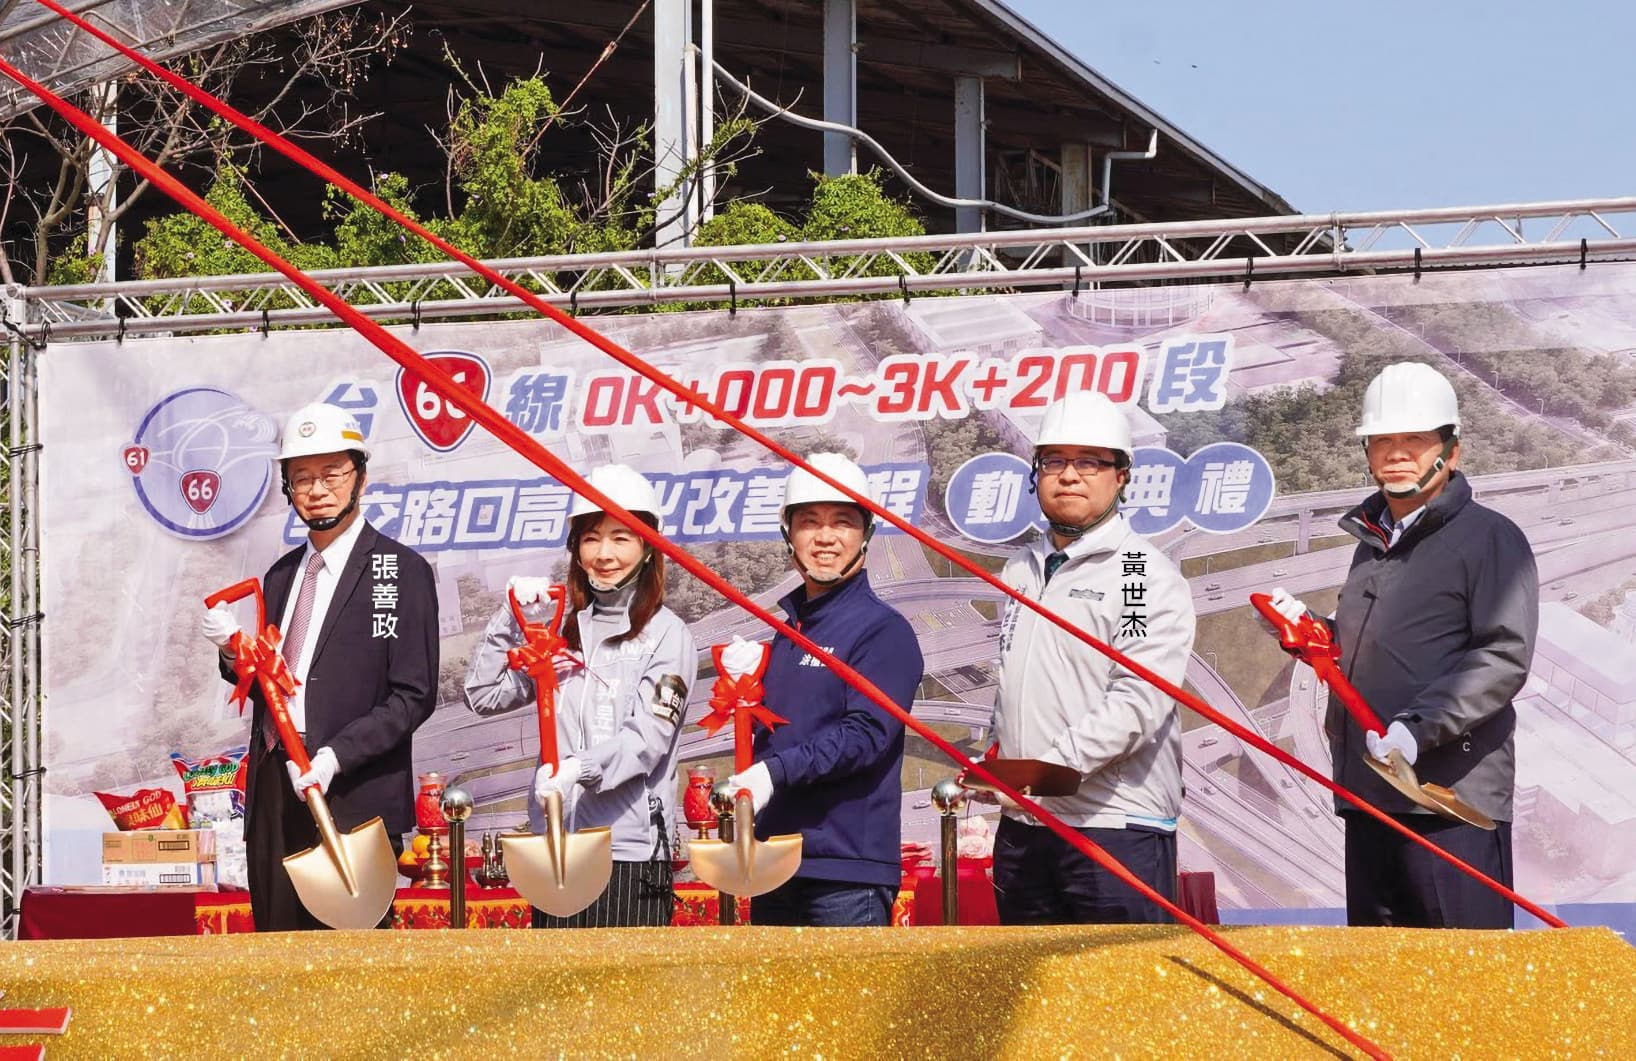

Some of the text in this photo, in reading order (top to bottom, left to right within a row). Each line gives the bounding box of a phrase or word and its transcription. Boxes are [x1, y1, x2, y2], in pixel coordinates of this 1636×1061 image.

[127, 451, 145, 466] 61
[188, 479, 213, 501] 66
[964, 460, 1256, 525] 動典禮
[142, 790, 162, 805] GOD
